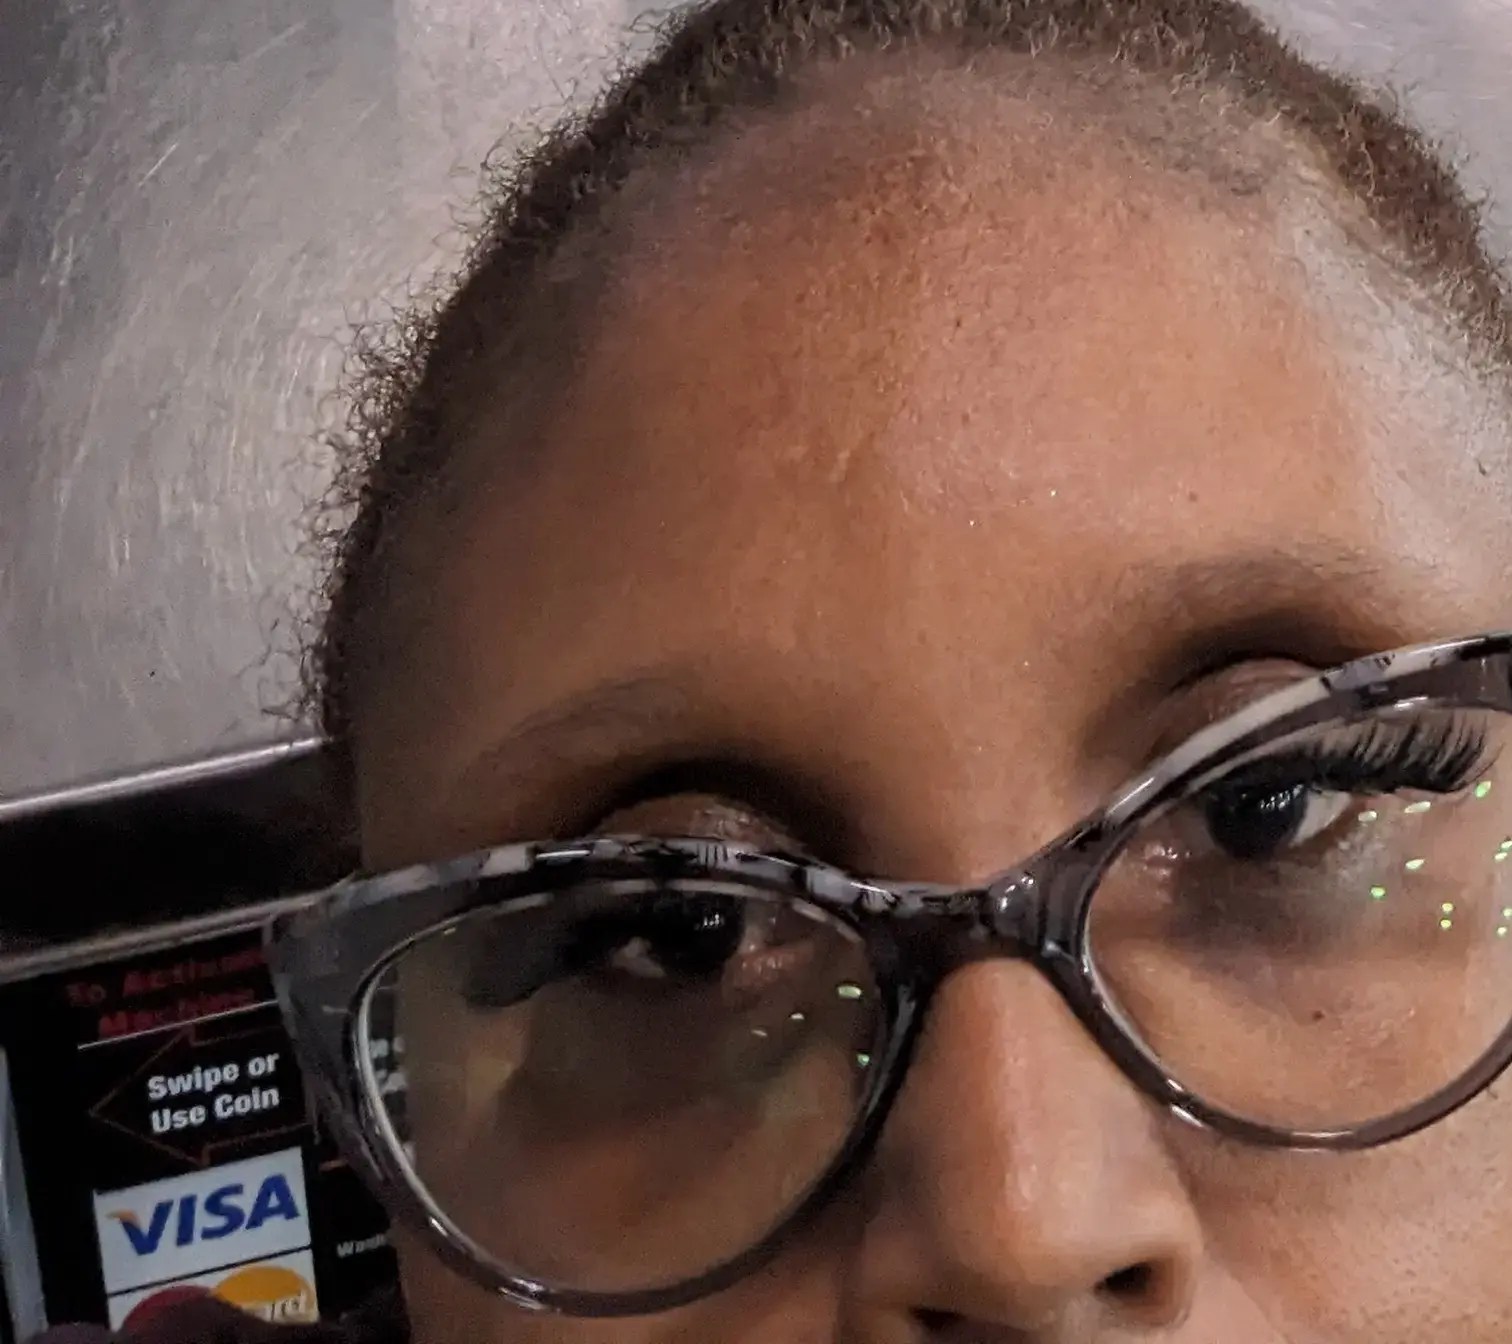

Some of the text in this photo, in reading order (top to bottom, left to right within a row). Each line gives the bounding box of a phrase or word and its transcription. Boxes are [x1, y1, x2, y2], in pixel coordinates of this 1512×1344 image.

[147, 1050, 281, 1101] Swipe or
[150, 1085, 281, 1135] Use Coin
[106, 1171, 301, 1258] VISA
